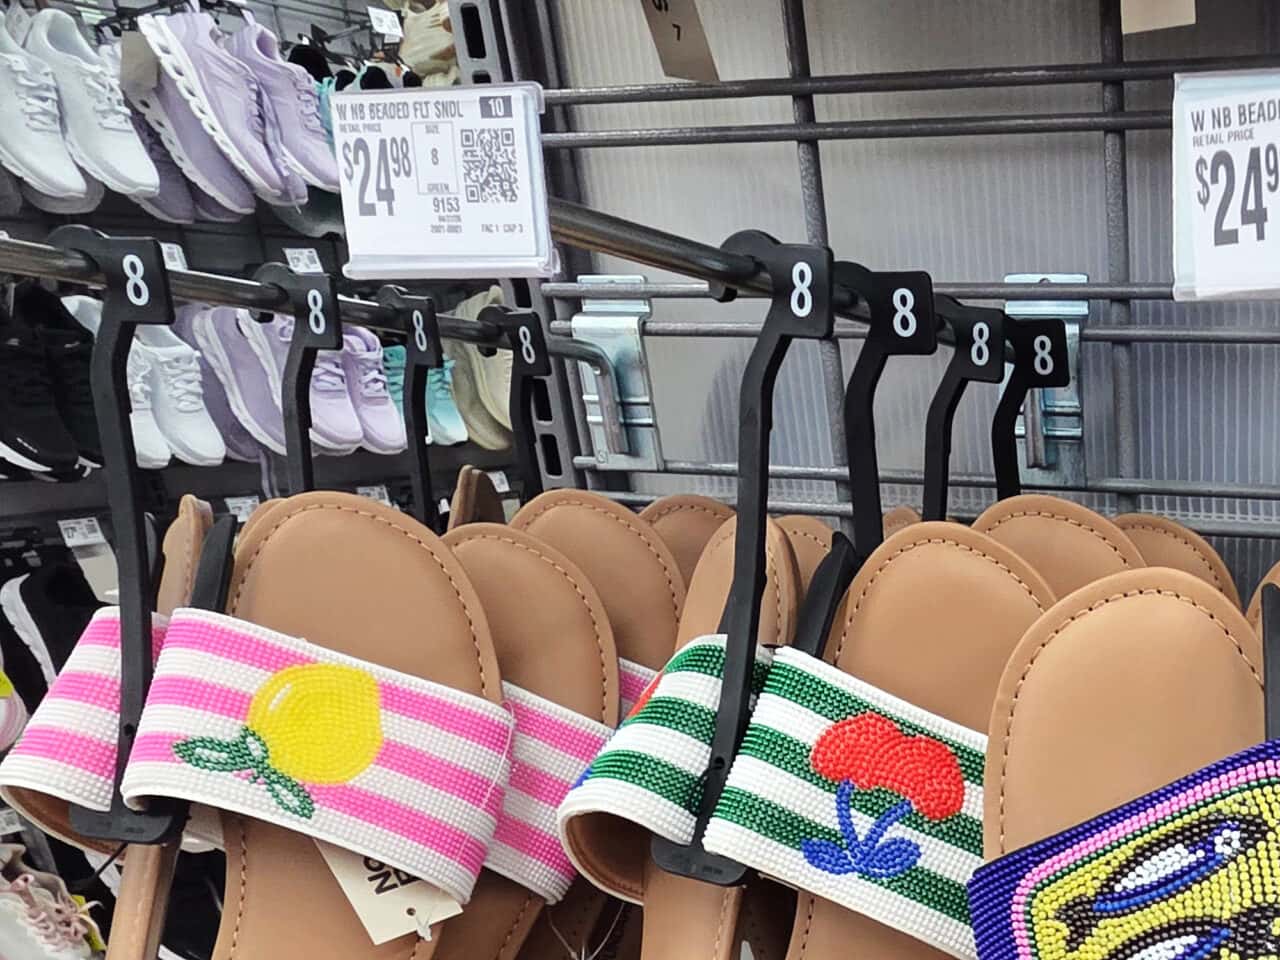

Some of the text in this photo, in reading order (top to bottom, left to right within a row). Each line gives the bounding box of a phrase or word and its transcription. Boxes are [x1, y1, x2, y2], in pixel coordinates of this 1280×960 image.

[336, 103, 346, 120] W
[369, 101, 409, 120] BEADED
[414, 101, 430, 119] FLT
[435, 100, 464, 118] SNDL
[487, 98, 505, 116] 10
[1191, 109, 1205, 133] W
[1211, 107, 1232, 130] NB
[431, 148, 439, 166] 8
[1192, 127, 1255, 147] RETAIL PRICE
[433, 197, 460, 213] 9153
[122, 254, 149, 307] 8
[790, 261, 812, 318] 8
[307, 289, 326, 335] 8
[411, 309, 427, 352] 8
[892, 287, 917, 338] 8
[519, 325, 536, 365] 8
[970, 321, 990, 366] 8
[1033, 335, 1054, 376] 8
